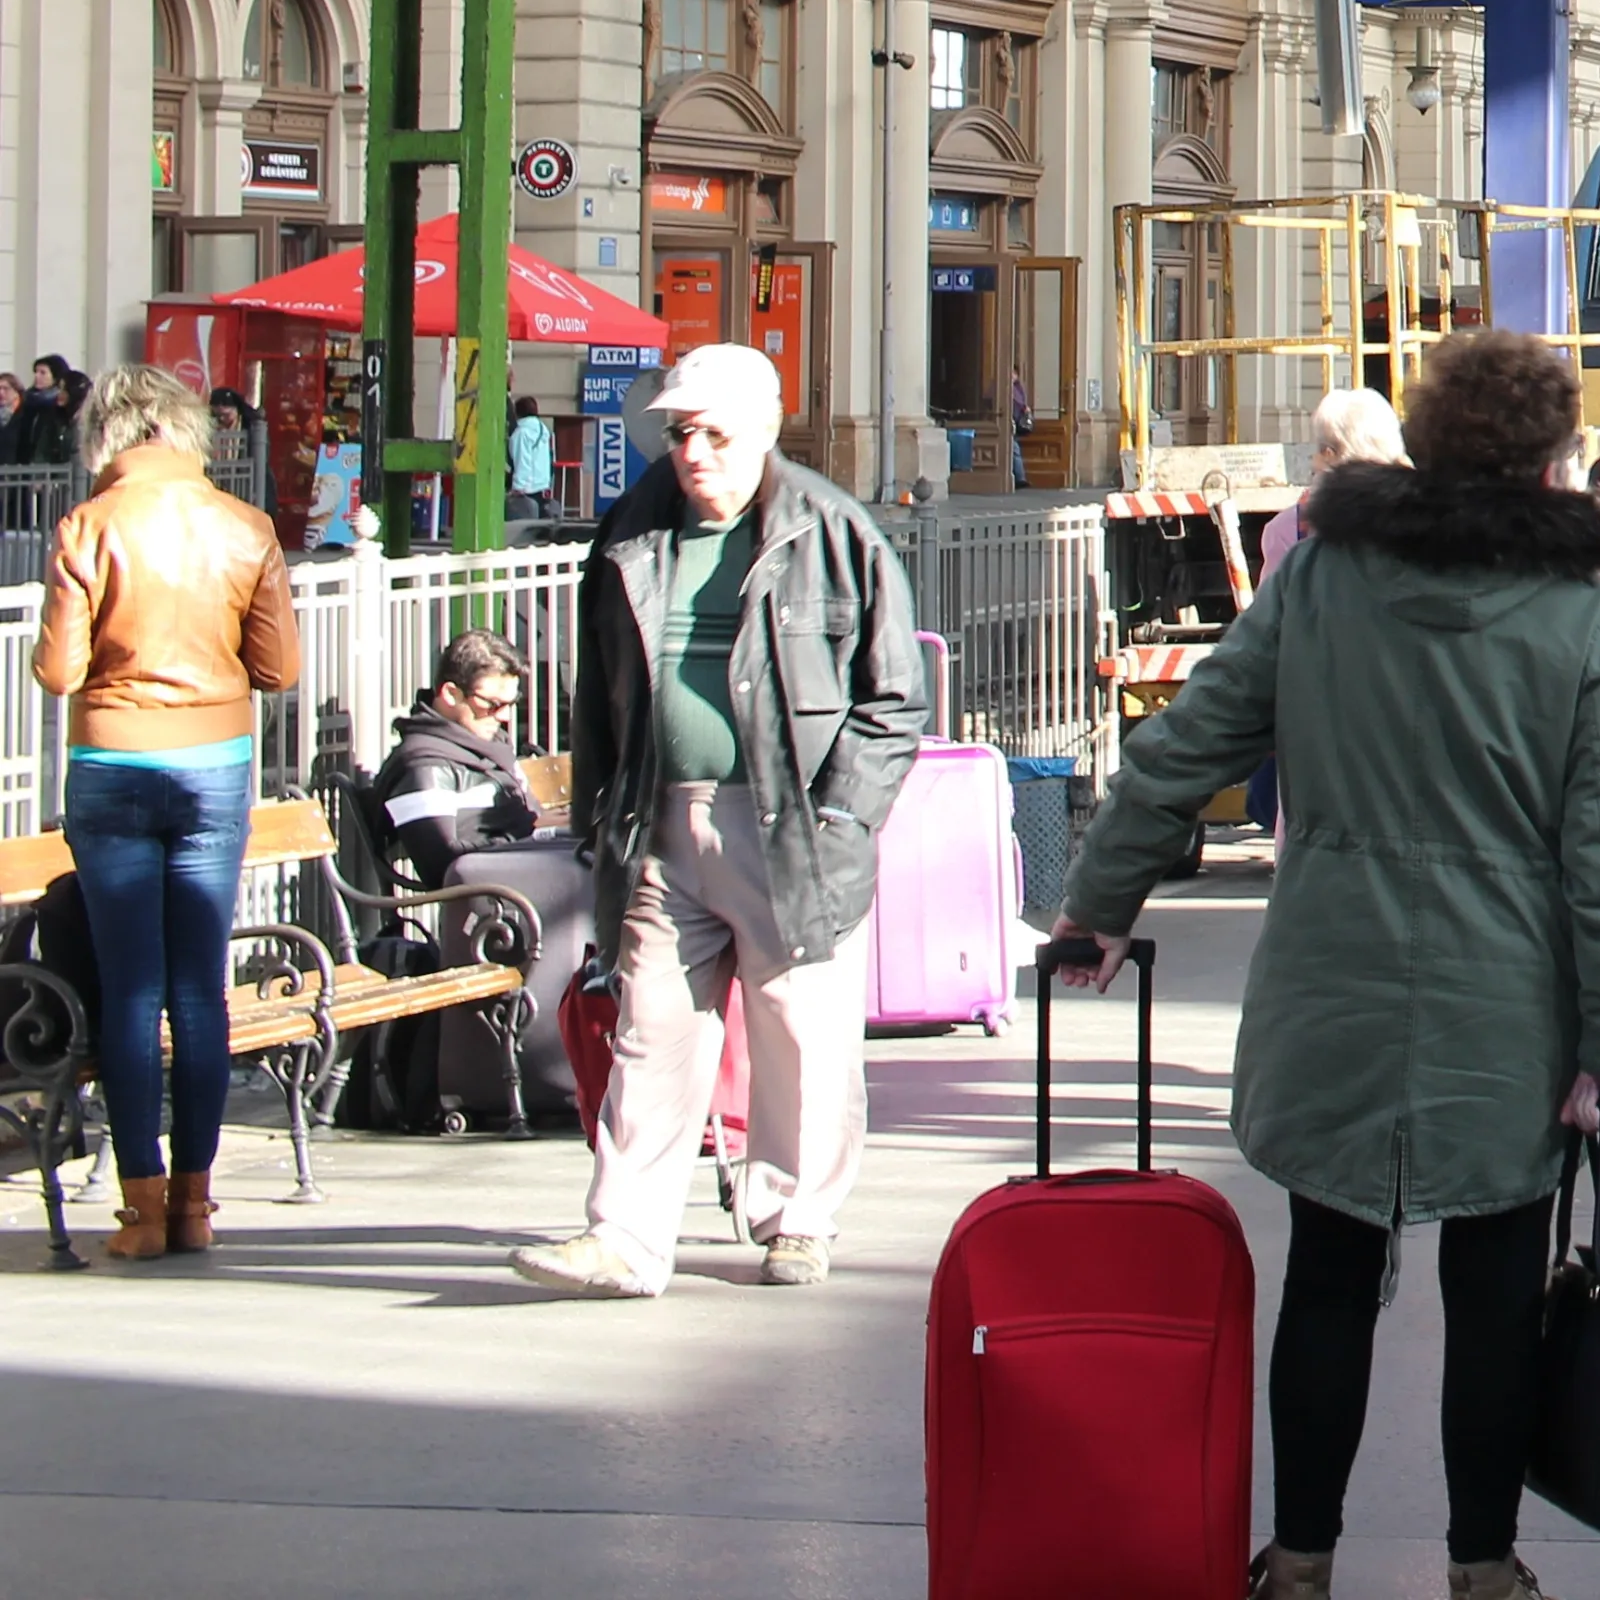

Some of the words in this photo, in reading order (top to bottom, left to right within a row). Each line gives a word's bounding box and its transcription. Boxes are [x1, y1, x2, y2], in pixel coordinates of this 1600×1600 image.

[555, 317, 587, 333] ALGIDA
[596, 350, 634, 362] ATM
[584, 378, 611, 390] EUR
[584, 390, 611, 402] HUF
[603, 422, 621, 491] ATM
